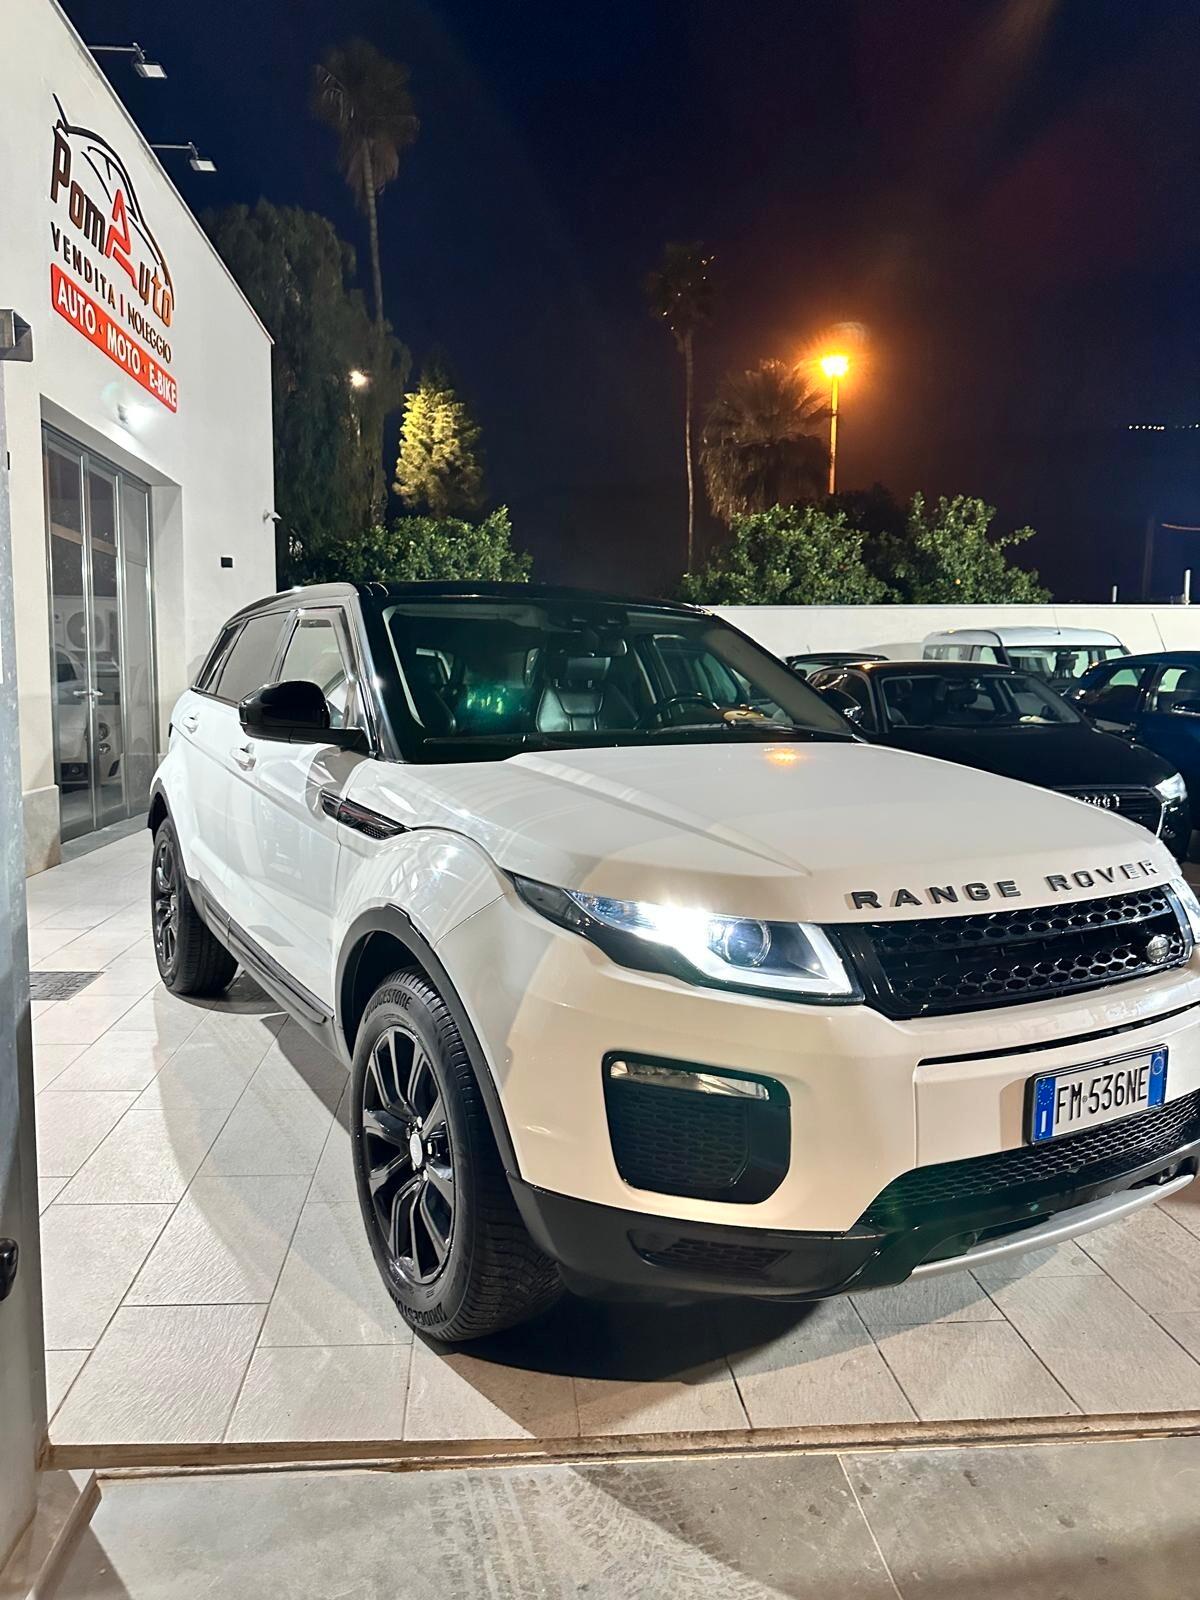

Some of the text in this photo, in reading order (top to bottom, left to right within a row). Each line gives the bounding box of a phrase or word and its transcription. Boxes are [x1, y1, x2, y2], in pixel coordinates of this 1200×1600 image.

[51, 221, 172, 364] VENDITA NOLEGGIO
[58, 277, 177, 408] AUTO MOTO E-BIKE
[849, 859, 1159, 909] RANGE ROVER
